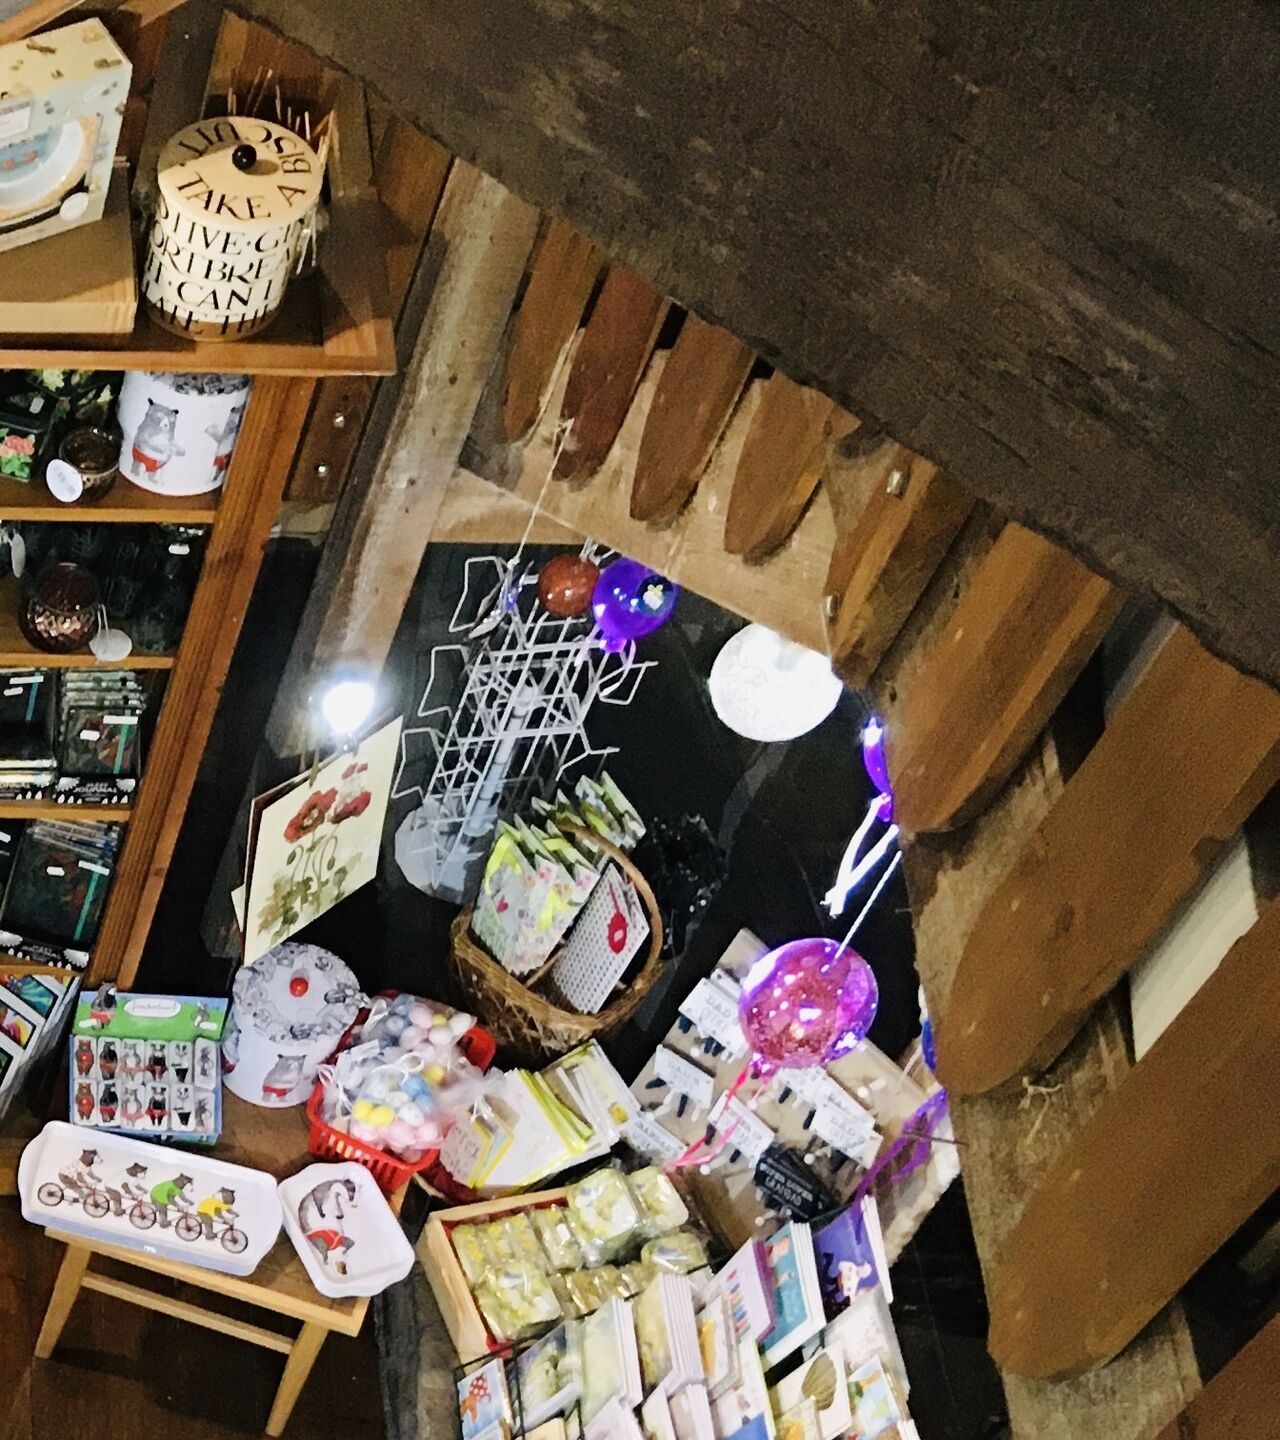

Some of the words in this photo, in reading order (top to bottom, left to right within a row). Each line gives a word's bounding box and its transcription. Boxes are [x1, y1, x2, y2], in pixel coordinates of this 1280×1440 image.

[176, 172, 272, 220] TAKE
[277, 183, 307, 208] A
[176, 280, 253, 310] CAN
